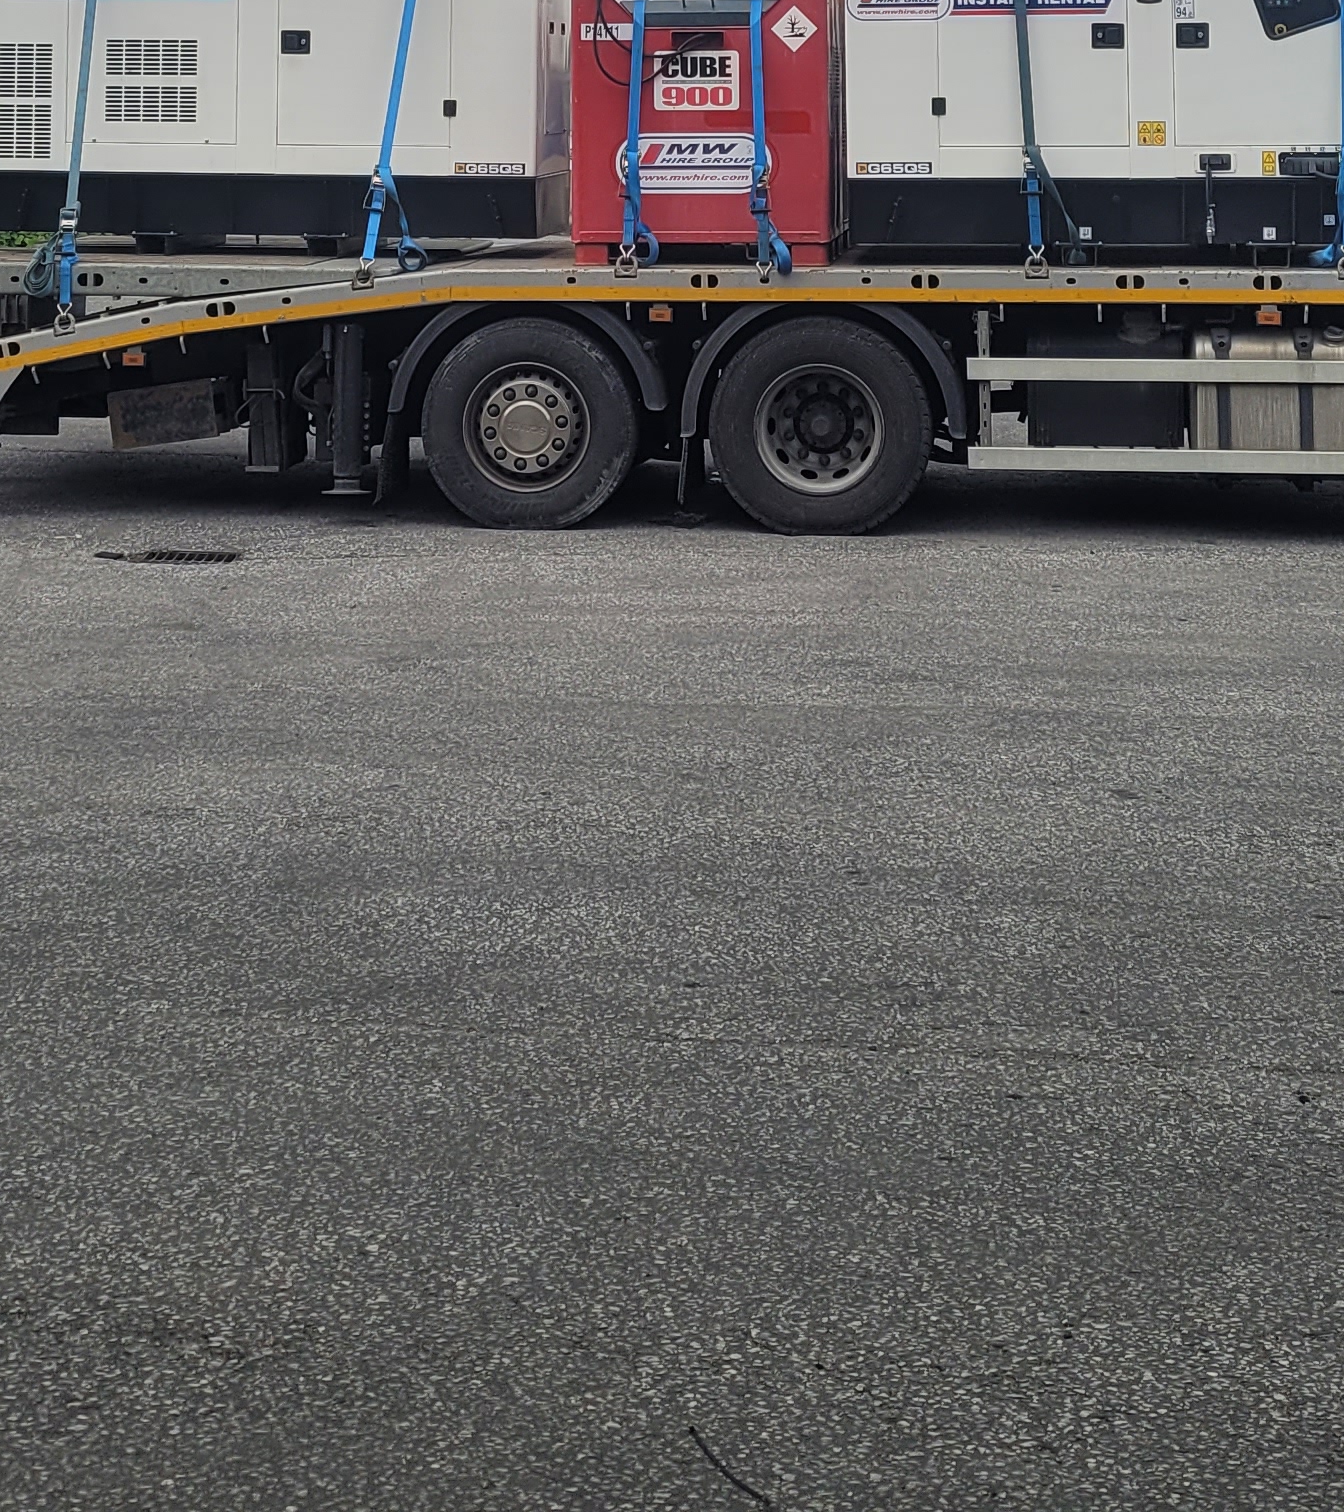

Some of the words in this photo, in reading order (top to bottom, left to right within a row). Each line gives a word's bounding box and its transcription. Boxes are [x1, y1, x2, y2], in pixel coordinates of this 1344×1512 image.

[1175, 7, 1187, 17] 94
[661, 56, 732, 78] CUBE
[661, 86, 733, 107] 900
[666, 143, 738, 155] MW
[466, 163, 524, 175] G65QS
[868, 163, 930, 174] G65QS
